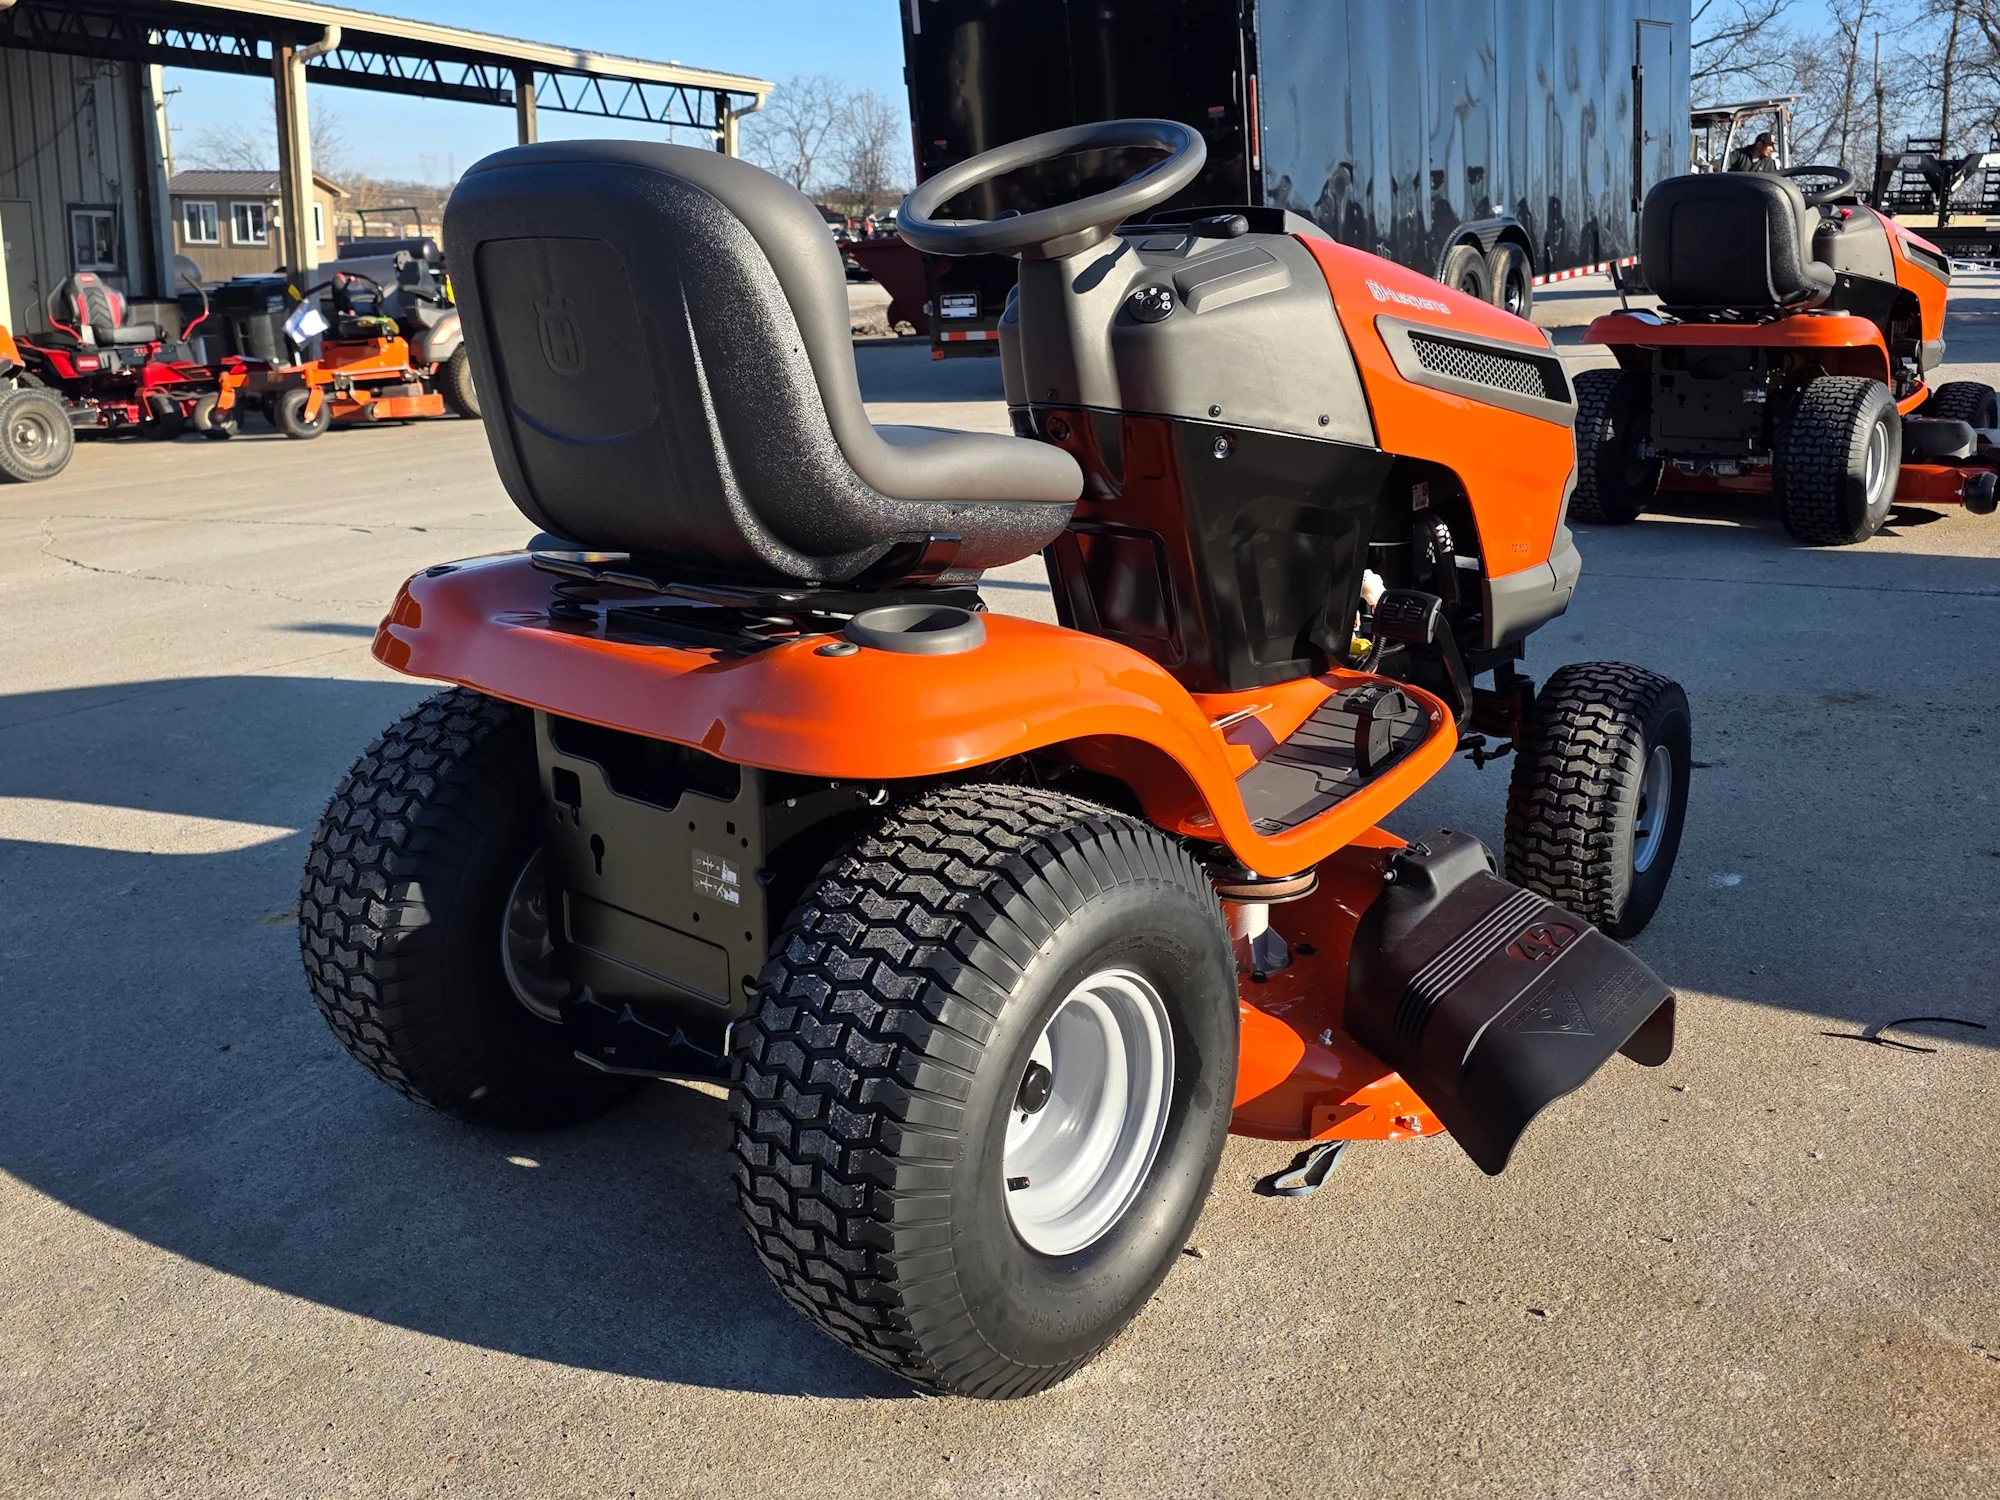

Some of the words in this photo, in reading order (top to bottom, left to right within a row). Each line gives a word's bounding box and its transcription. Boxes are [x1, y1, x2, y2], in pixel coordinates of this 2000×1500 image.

[1384, 284, 1452, 315] Husqvarna
[1516, 924, 1576, 961] 42
[1202, 1053, 1231, 1164] WANDA
[1028, 1307, 1053, 1333] NHS
